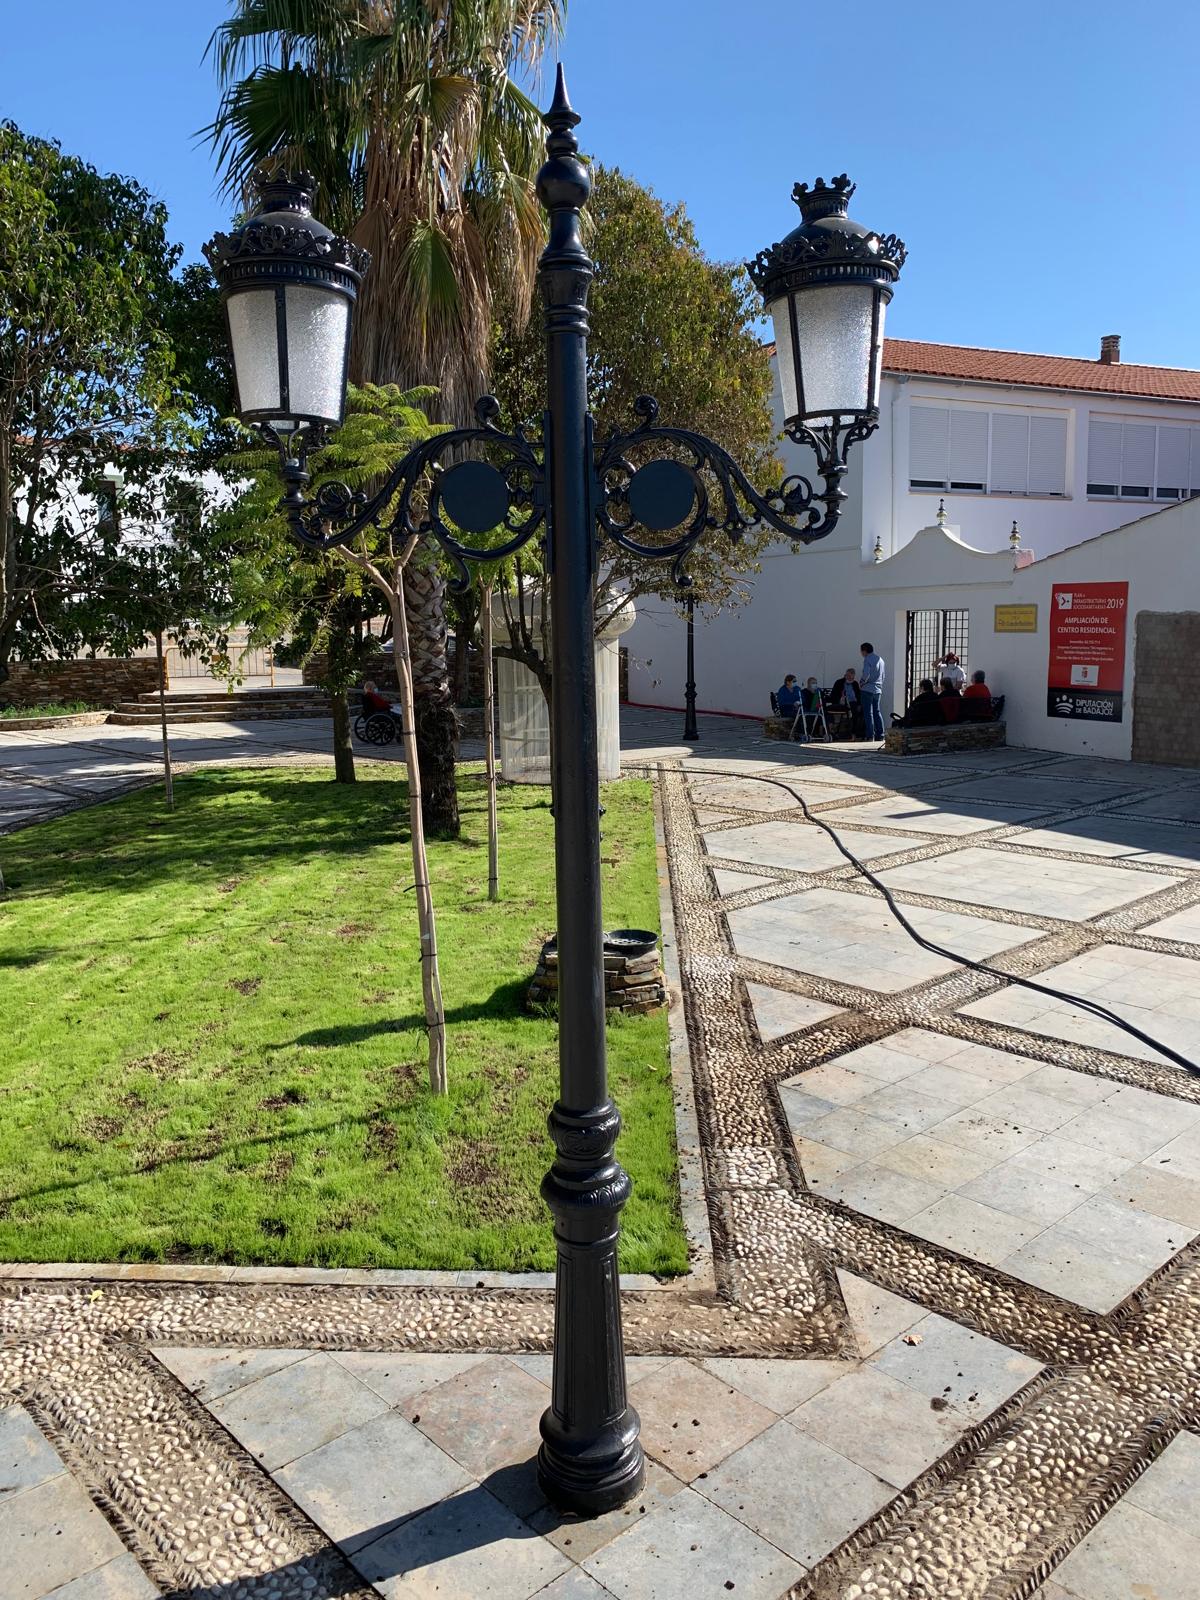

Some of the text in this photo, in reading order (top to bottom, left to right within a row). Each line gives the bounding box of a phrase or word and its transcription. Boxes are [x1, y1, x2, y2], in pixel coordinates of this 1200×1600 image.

[1107, 598, 1124, 609] 2019
[1065, 616, 1099, 624] AMPLIACIÓN
[1076, 699, 1113, 708] DIPUTACIÓN
[1083, 707, 1113, 715] BADAJOZ
